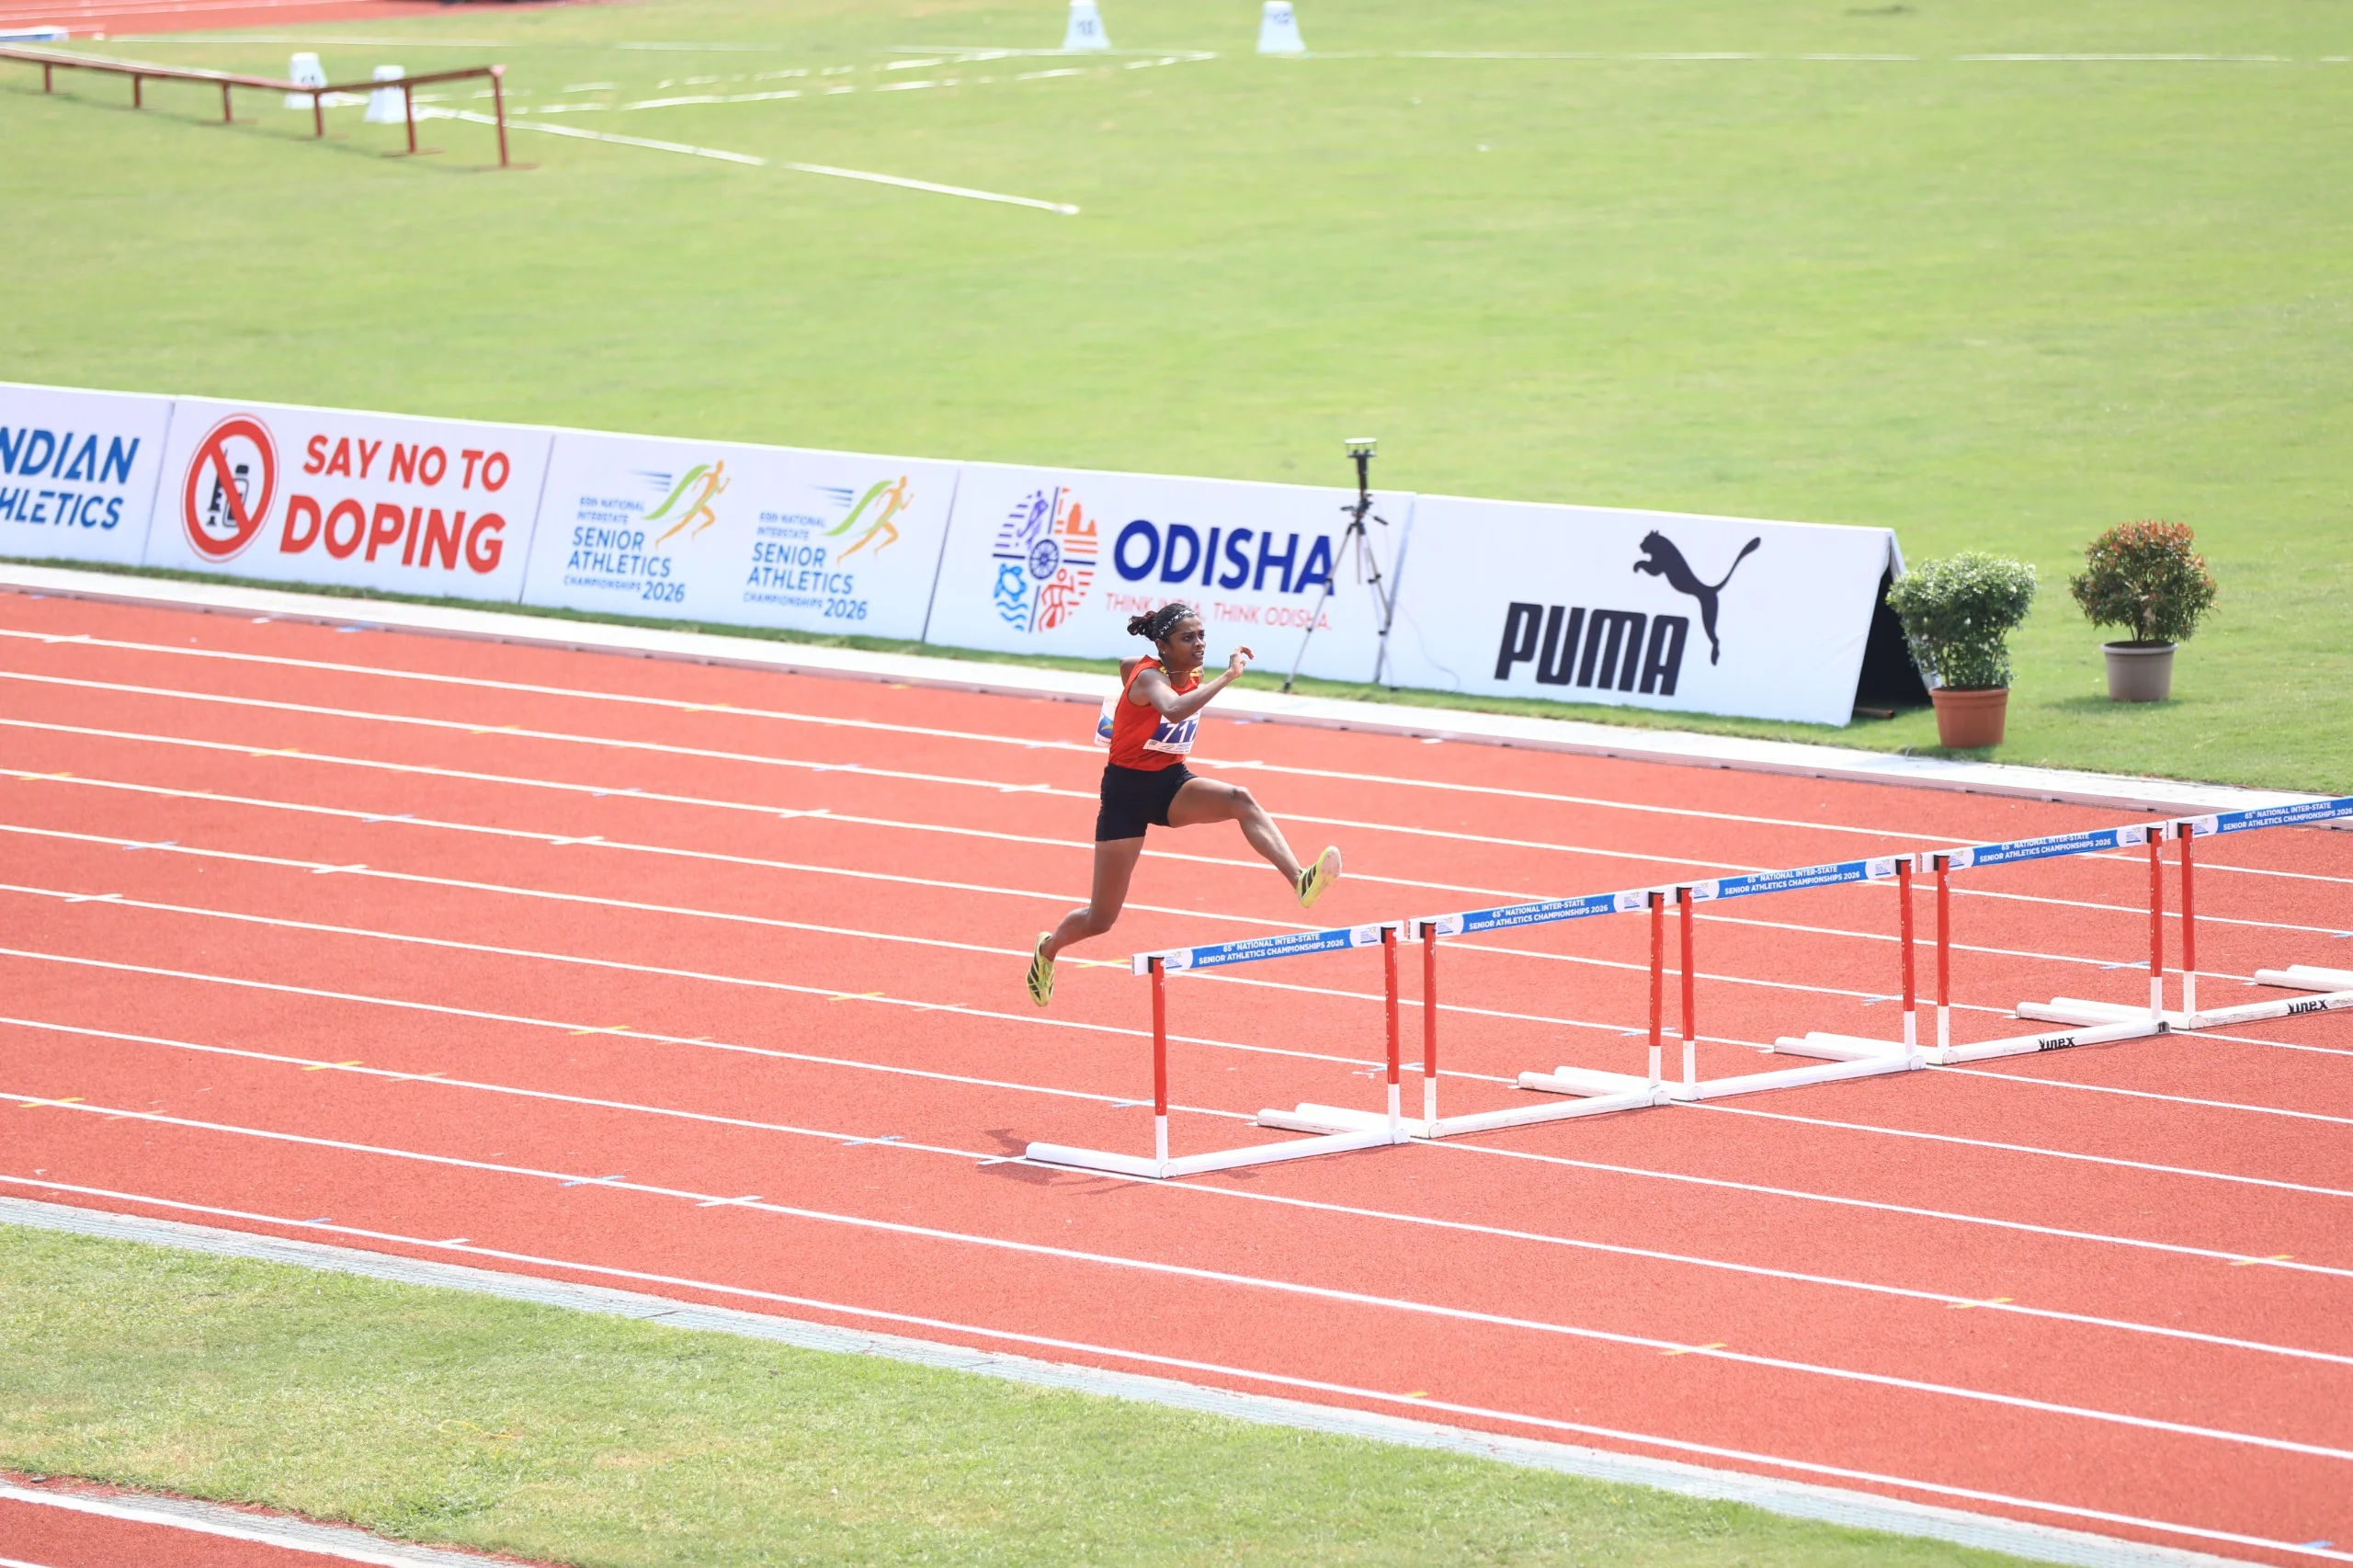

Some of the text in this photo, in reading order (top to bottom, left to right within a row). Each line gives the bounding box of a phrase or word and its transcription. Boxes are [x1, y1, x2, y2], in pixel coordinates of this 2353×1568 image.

[303, 434, 511, 492] SAY NO TO
[279, 494, 506, 574] DOPING
[572, 527, 644, 551] SENIOR
[567, 551, 671, 577] ATHLETICS
[752, 541, 825, 567] SENIOR
[1114, 519, 1336, 597] ODISHA
[563, 574, 686, 603] CHAMPIONSHIPS 2026
[746, 566, 853, 595] ATHLETICS
[743, 592, 868, 619] CHAMPIONSHIPS 2026
[1106, 592, 1154, 612] THINK
[1213, 602, 1260, 624] THINK
[1495, 602, 1689, 696] PUMA
[1162, 720, 1198, 743] 717
[2223, 822, 2247, 830] SENIOR
[2248, 817, 2282, 827] ATHLETICS
[2283, 810, 2336, 822] CHAMPIONSHIPS
[2257, 808, 2290, 817] NATIONAL
[2290, 802, 2331, 812] INTER-STATE
[1980, 838, 2111, 862] SENIOR ATHLETICS CHAMPIONSHIPS 2026
[2014, 838, 2048, 849] NATIONAL
[1725, 871, 1860, 895] SENIOR ATHLETICS CHAMPIONSHIPS 2026
[1760, 870, 1794, 881] NATIONAL
[1796, 865, 1837, 877] INTER-STATE
[1469, 904, 1608, 930] SENIOR ATHLETICS CHAMPIONSHIPS 2026
[1506, 905, 1540, 916] NATIONAL
[1541, 899, 1585, 912] INTER-STATE
[1199, 938, 1344, 965] SENIOR ATHLETICS CHAMPIONSHIPS 2026
[1236, 938, 1274, 950] NATIONAL
[1275, 933, 1320, 945] INTER-STATE
